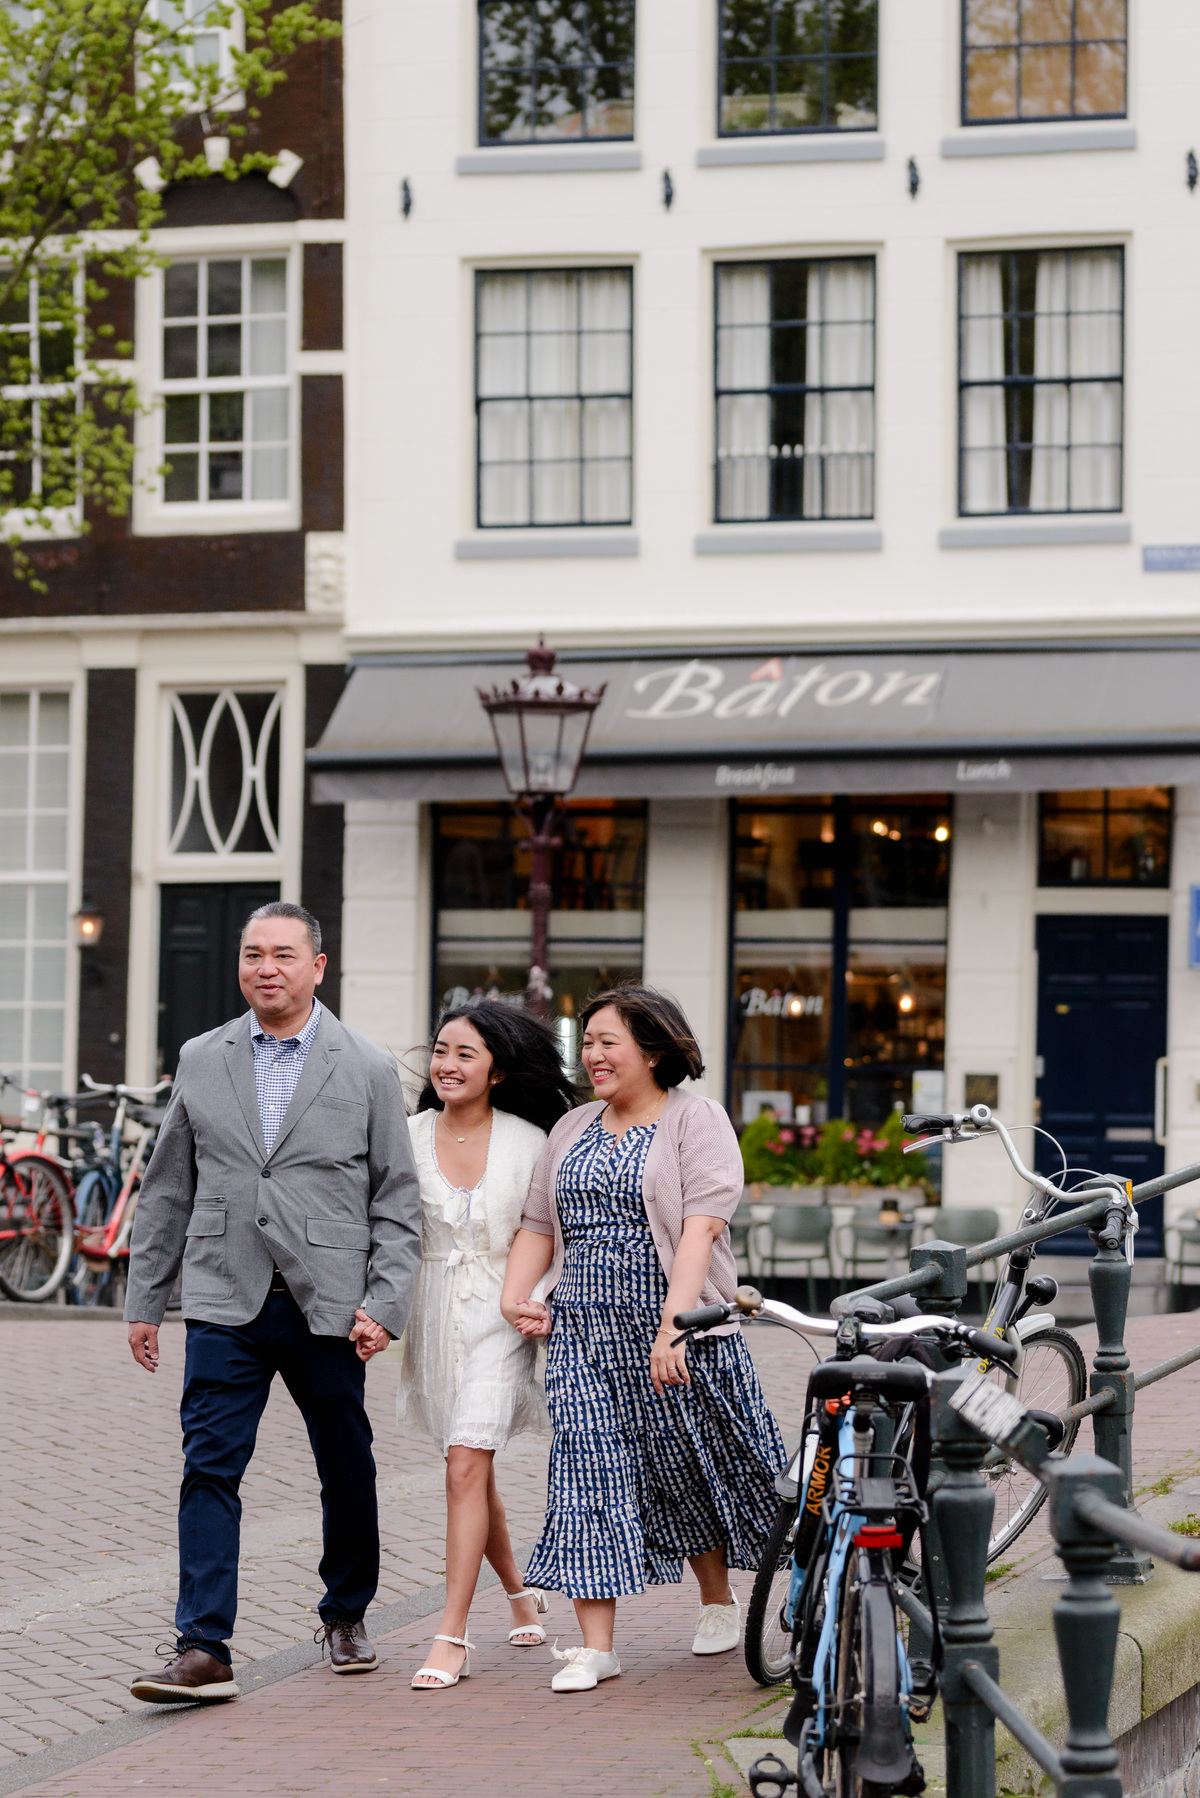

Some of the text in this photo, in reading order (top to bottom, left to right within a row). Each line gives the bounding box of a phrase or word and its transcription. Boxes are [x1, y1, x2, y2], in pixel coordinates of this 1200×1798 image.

[625, 657, 940, 719] Bâton
[715, 763, 796, 791] Breakfast
[956, 759, 1011, 781] Lunch
[806, 1445, 832, 1515] ARMOR
